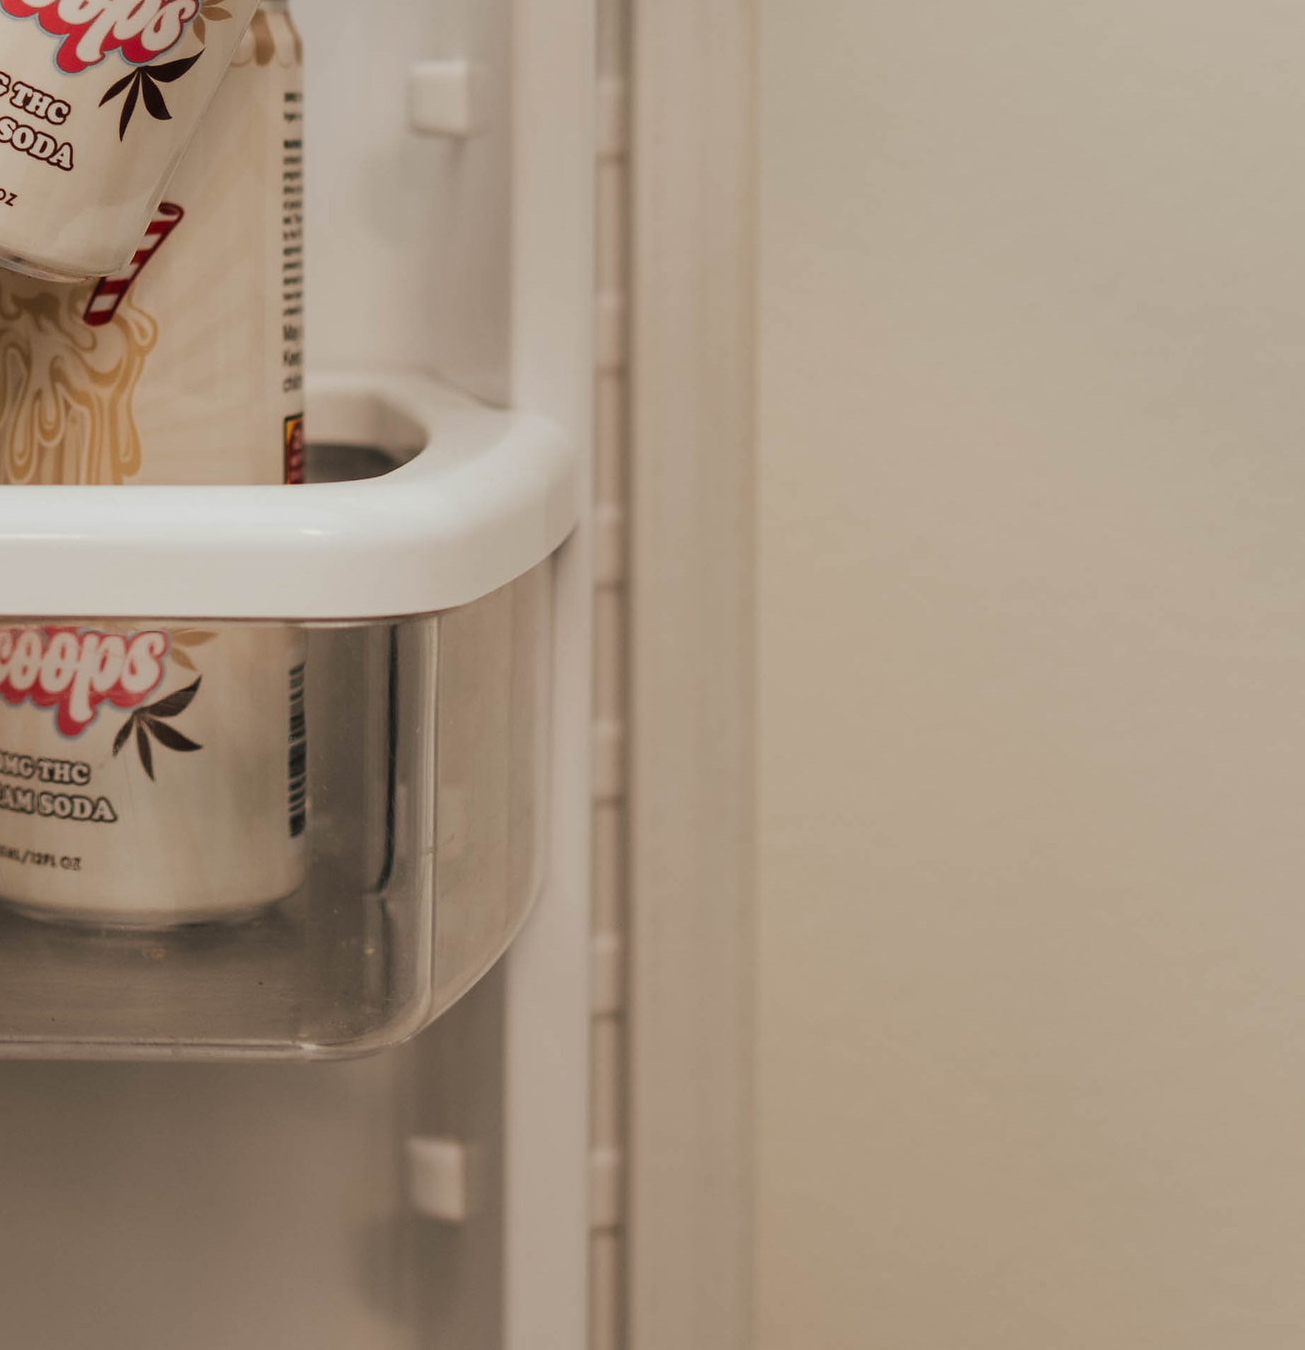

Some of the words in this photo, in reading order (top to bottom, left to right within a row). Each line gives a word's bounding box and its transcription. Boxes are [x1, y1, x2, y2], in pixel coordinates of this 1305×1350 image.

[10, 81, 71, 125] THC
[36, 757, 91, 786] THC
[38, 792, 118, 823] SODA
